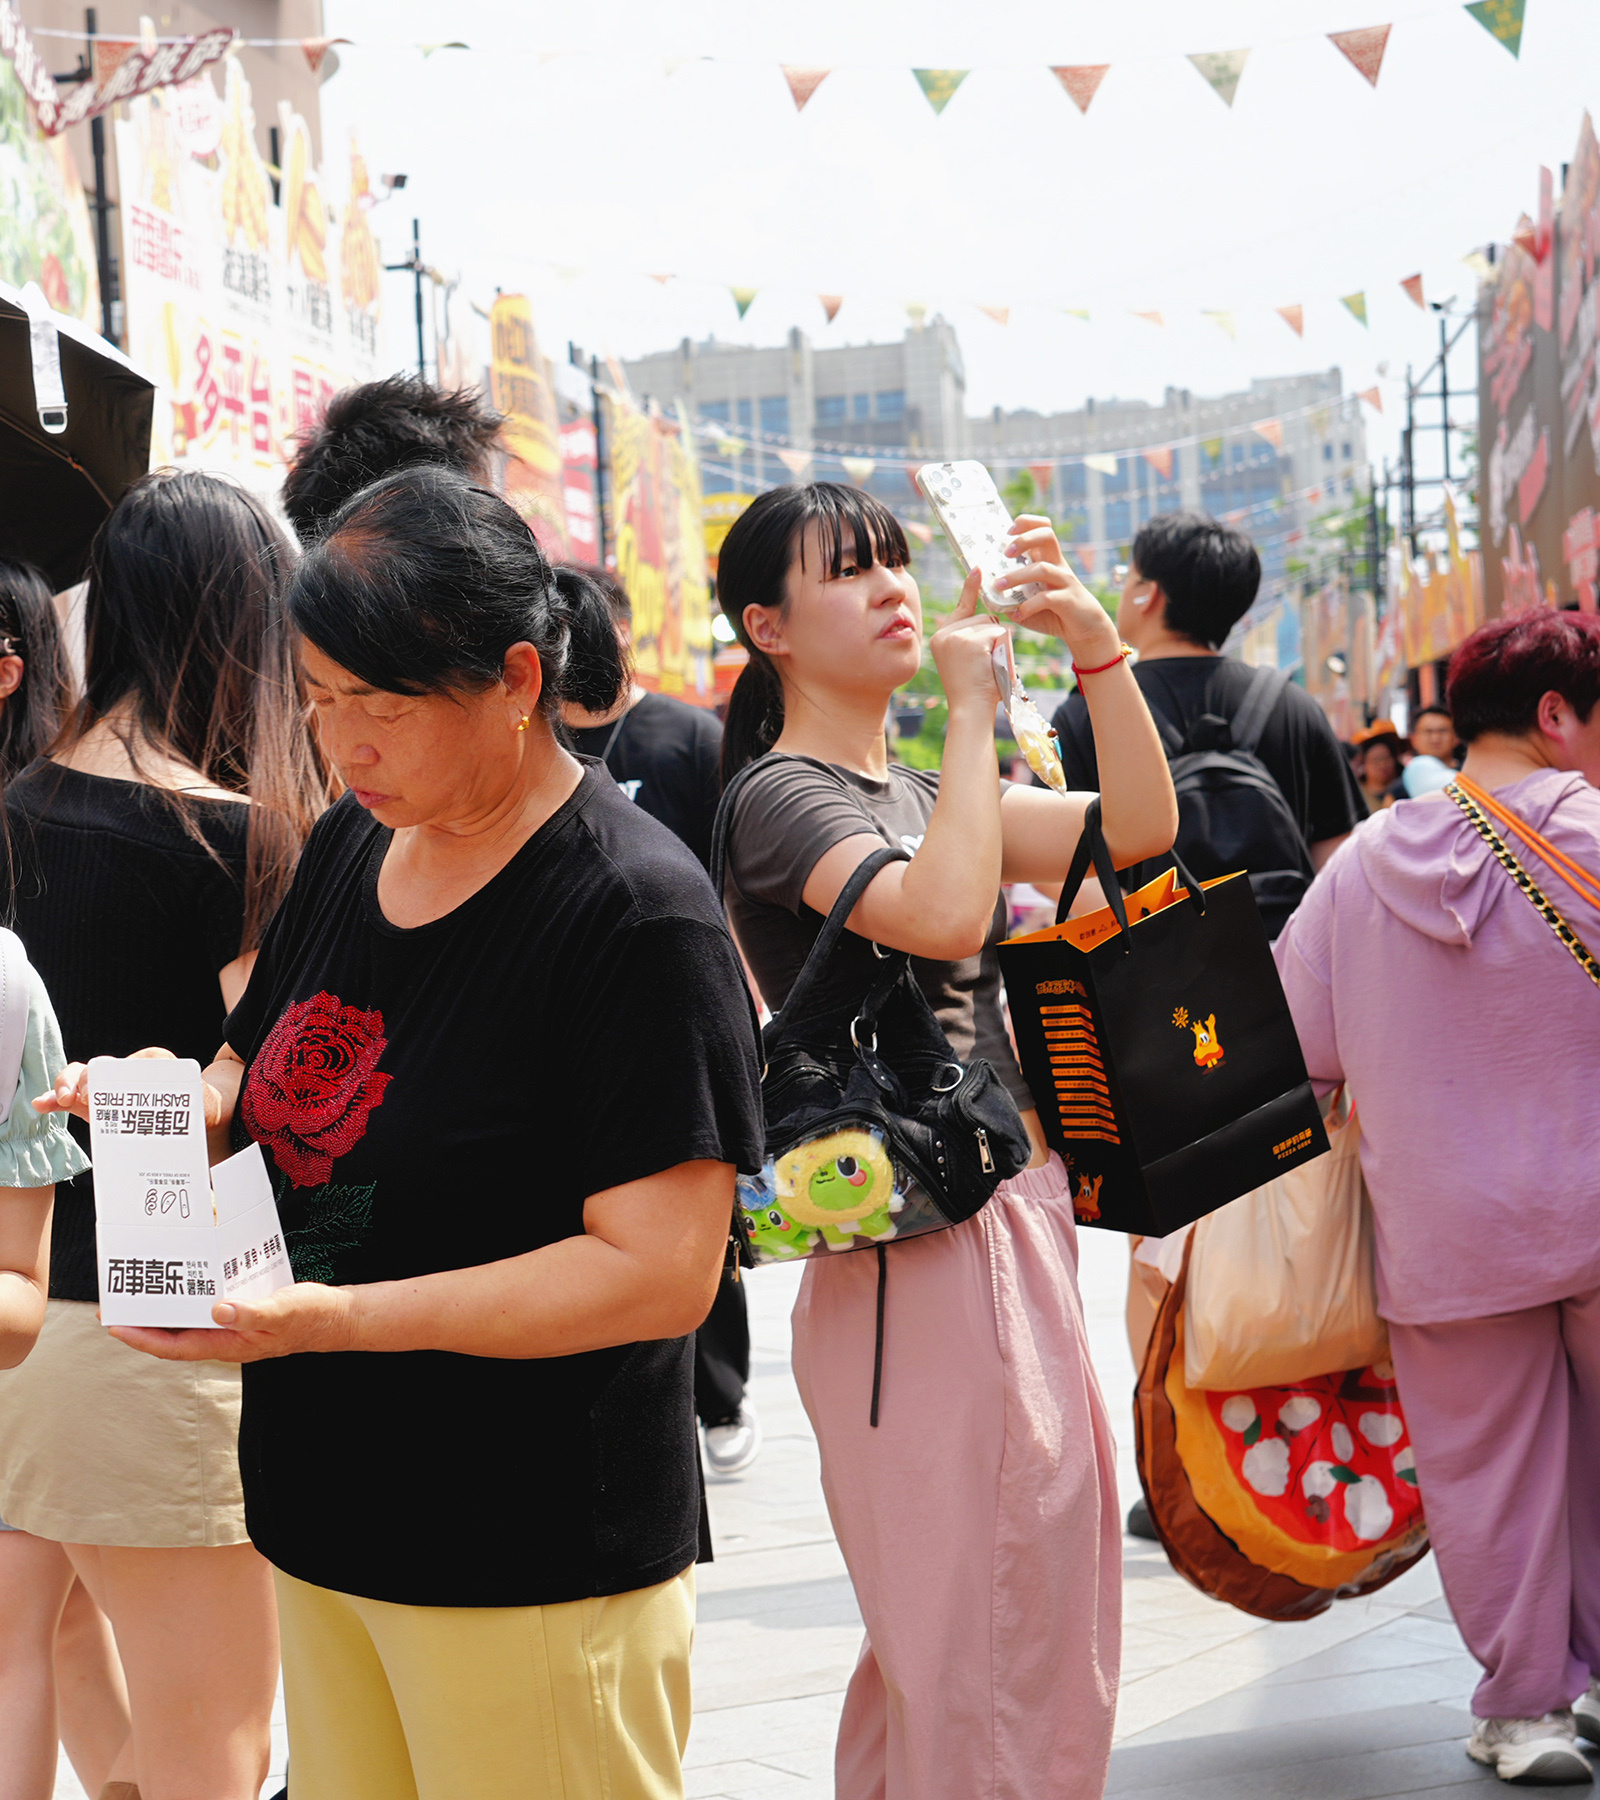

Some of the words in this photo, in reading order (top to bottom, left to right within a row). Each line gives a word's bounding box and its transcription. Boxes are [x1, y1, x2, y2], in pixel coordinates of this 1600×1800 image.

[93, 1092, 125, 1106] FRIES
[126, 1093, 151, 1106] XILE
[152, 1093, 190, 1107] BAISHI
[120, 1109, 190, 1136] 百事喜乐
[108, 1258, 184, 1295] 百事喜乐
[187, 1279, 215, 1295] 薯条店
